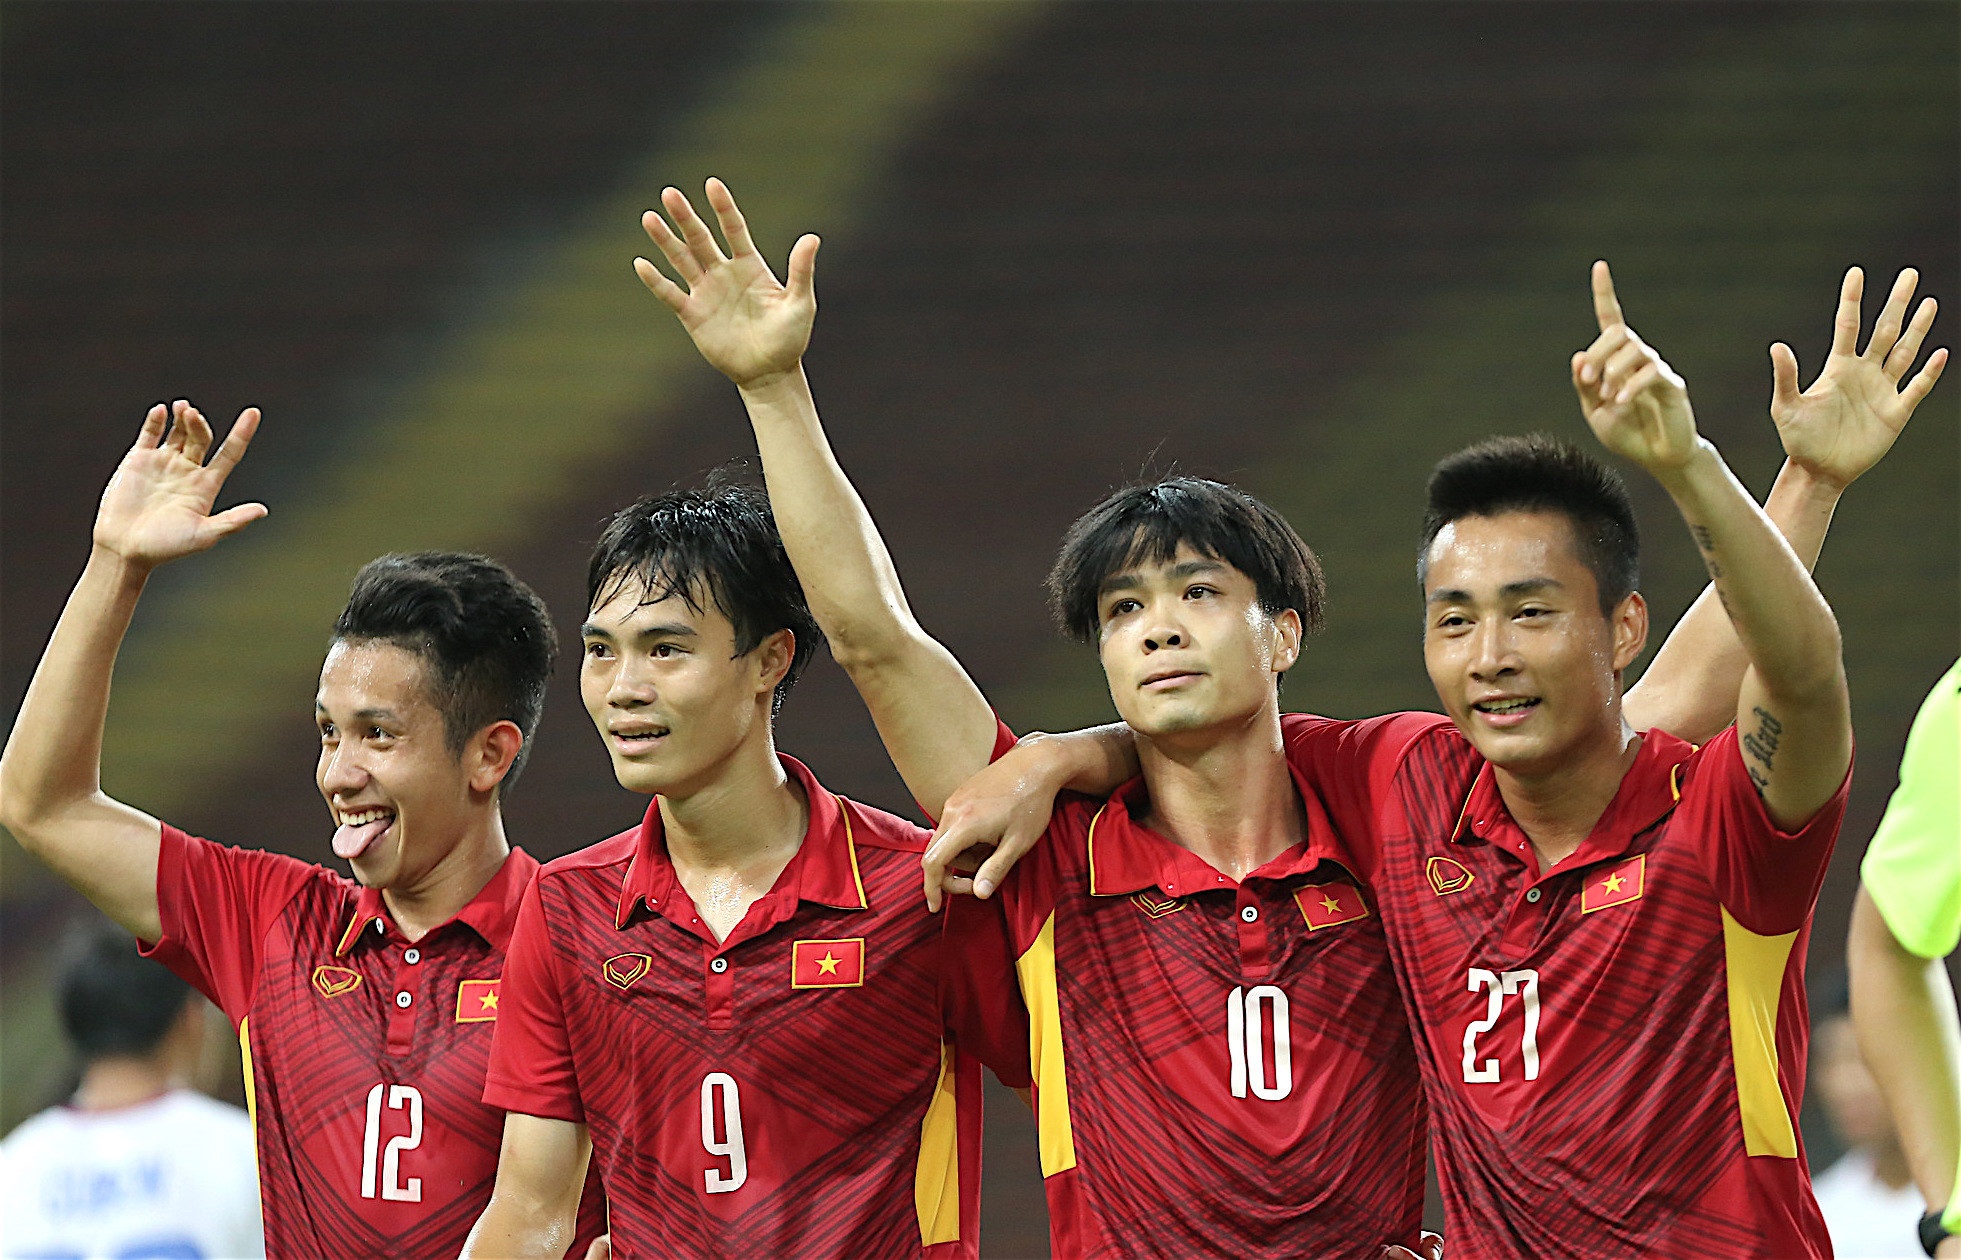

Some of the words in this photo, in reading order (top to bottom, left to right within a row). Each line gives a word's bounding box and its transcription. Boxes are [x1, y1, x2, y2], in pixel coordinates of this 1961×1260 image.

[1227, 985, 1293, 1101] 10
[1462, 967, 1540, 1084] 27
[361, 1083, 423, 1203] 12
[701, 1072, 748, 1194] 9
